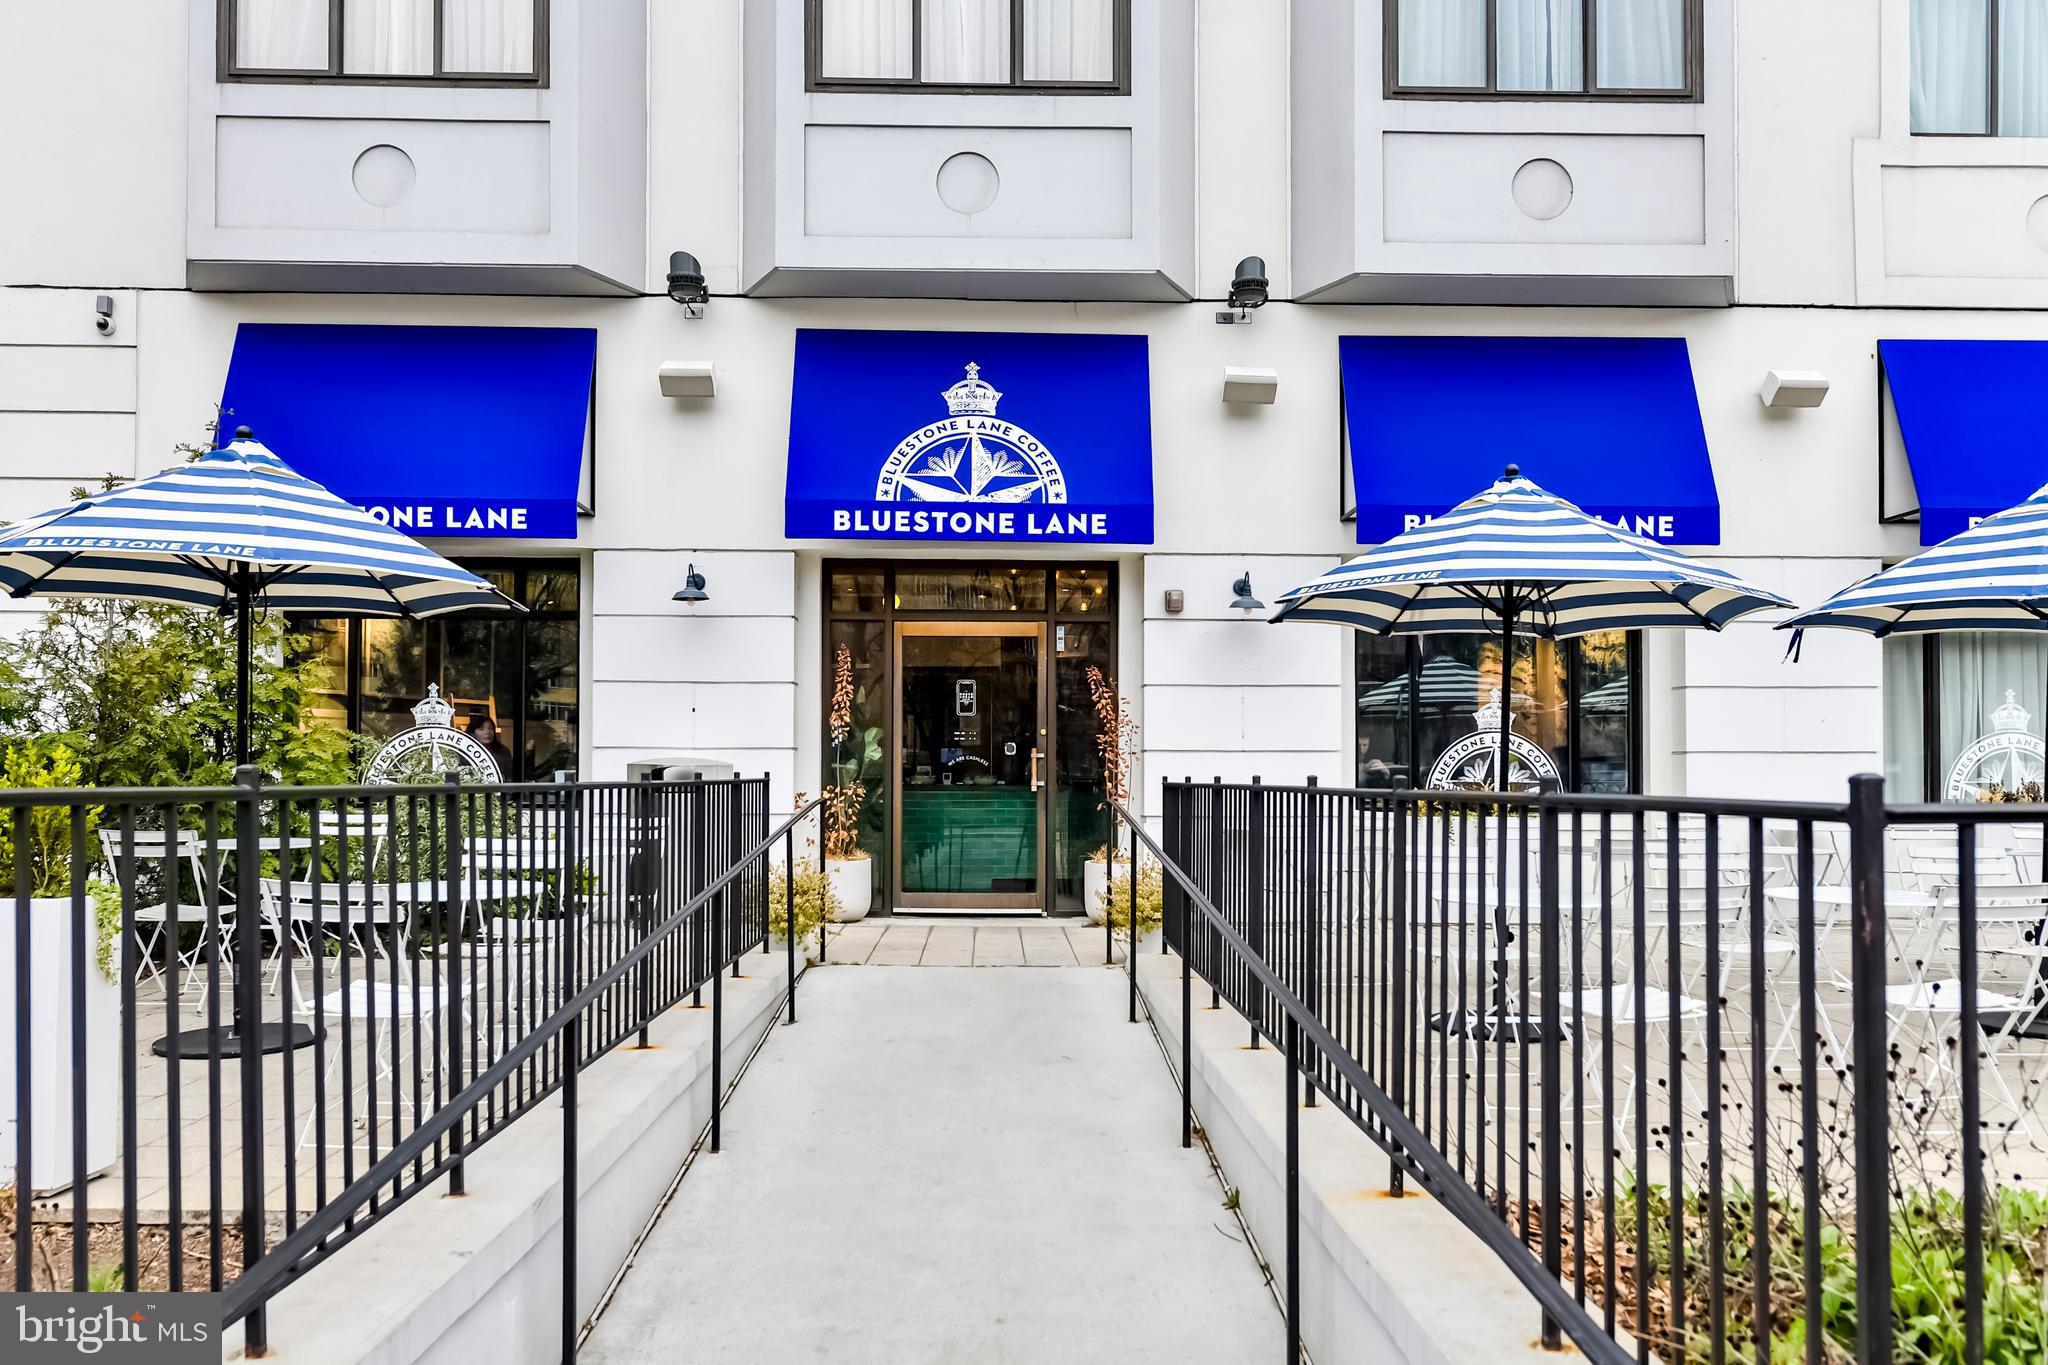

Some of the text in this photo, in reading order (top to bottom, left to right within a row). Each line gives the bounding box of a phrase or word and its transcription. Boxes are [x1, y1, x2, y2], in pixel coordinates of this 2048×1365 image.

[882, 419, 1061, 487] BLUESTONE LANE COFFEE
[446, 507, 528, 529] LANE
[833, 510, 1107, 535] BLUESTONE LANE
[24, 538, 257, 557] BLUESTONE LANE
[1296, 570, 1442, 595] BLUESTONE LANE
[429, 731, 463, 746] LANE
[1491, 736, 1524, 751] LNE
[966, 755, 989, 766] CASHLESS
[1951, 737, 2040, 791] BLUESTONE LANE
